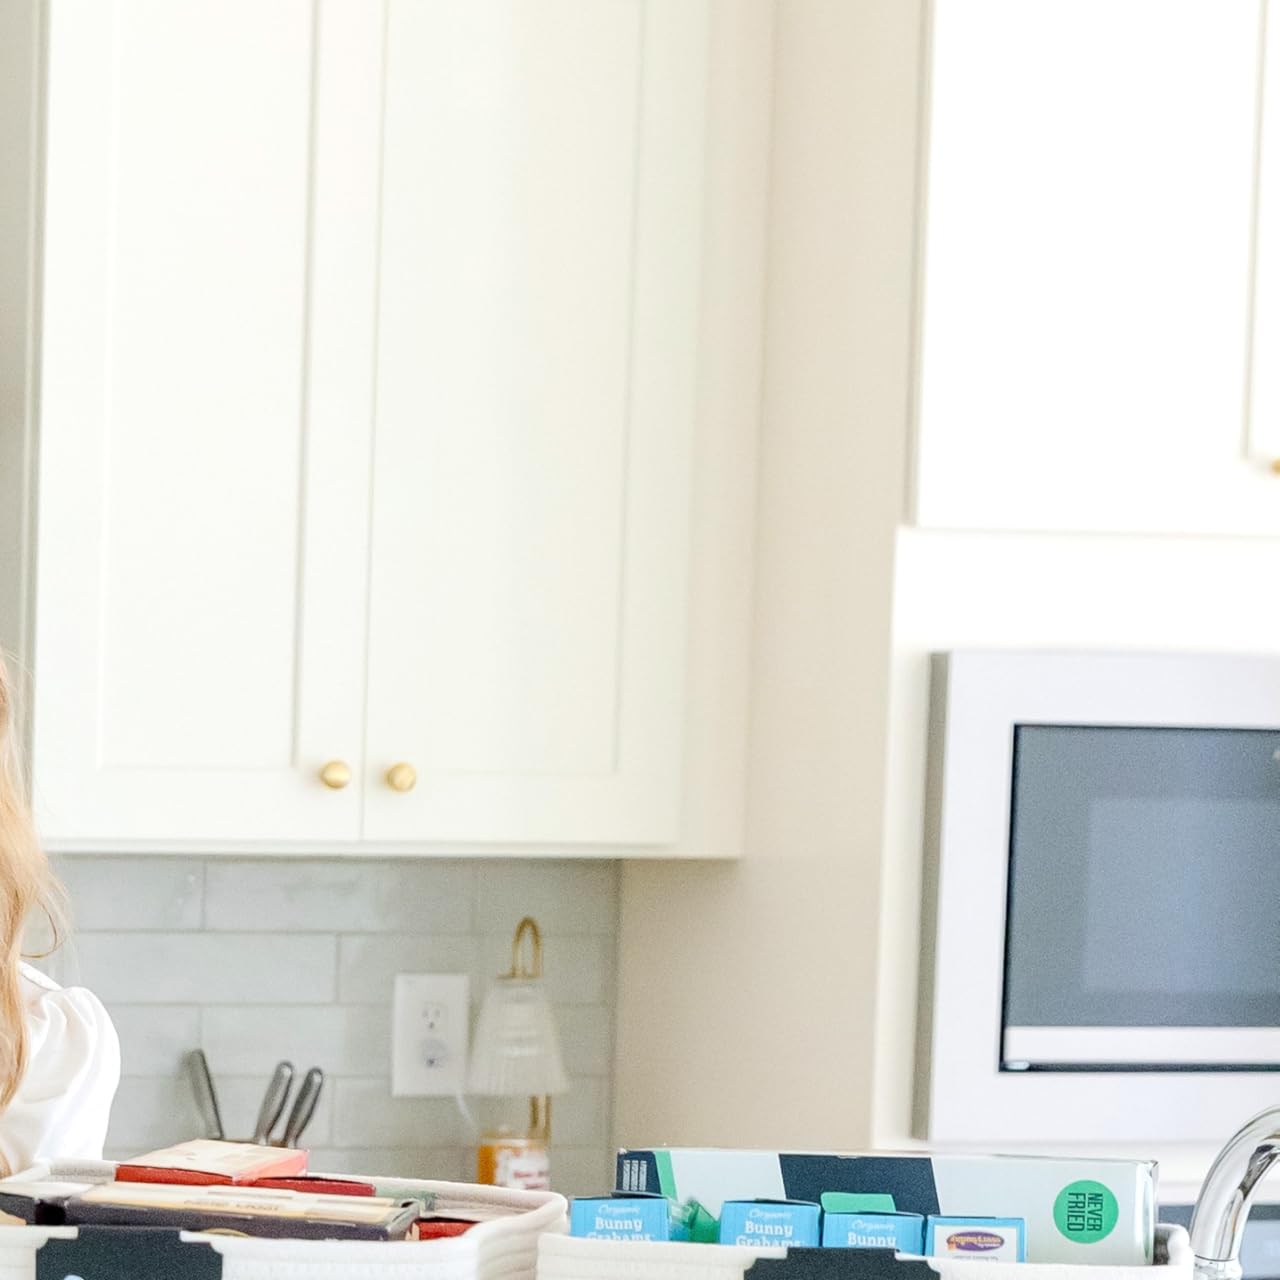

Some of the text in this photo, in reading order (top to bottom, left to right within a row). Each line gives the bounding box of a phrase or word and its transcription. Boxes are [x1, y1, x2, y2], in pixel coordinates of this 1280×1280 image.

[1066, 1192, 1086, 1232] FRIED
[1086, 1192, 1104, 1232] NEVER
[594, 1216, 643, 1232] Bunny
[744, 1220, 794, 1238] Bunny
[847, 1231, 897, 1248] Bunny
